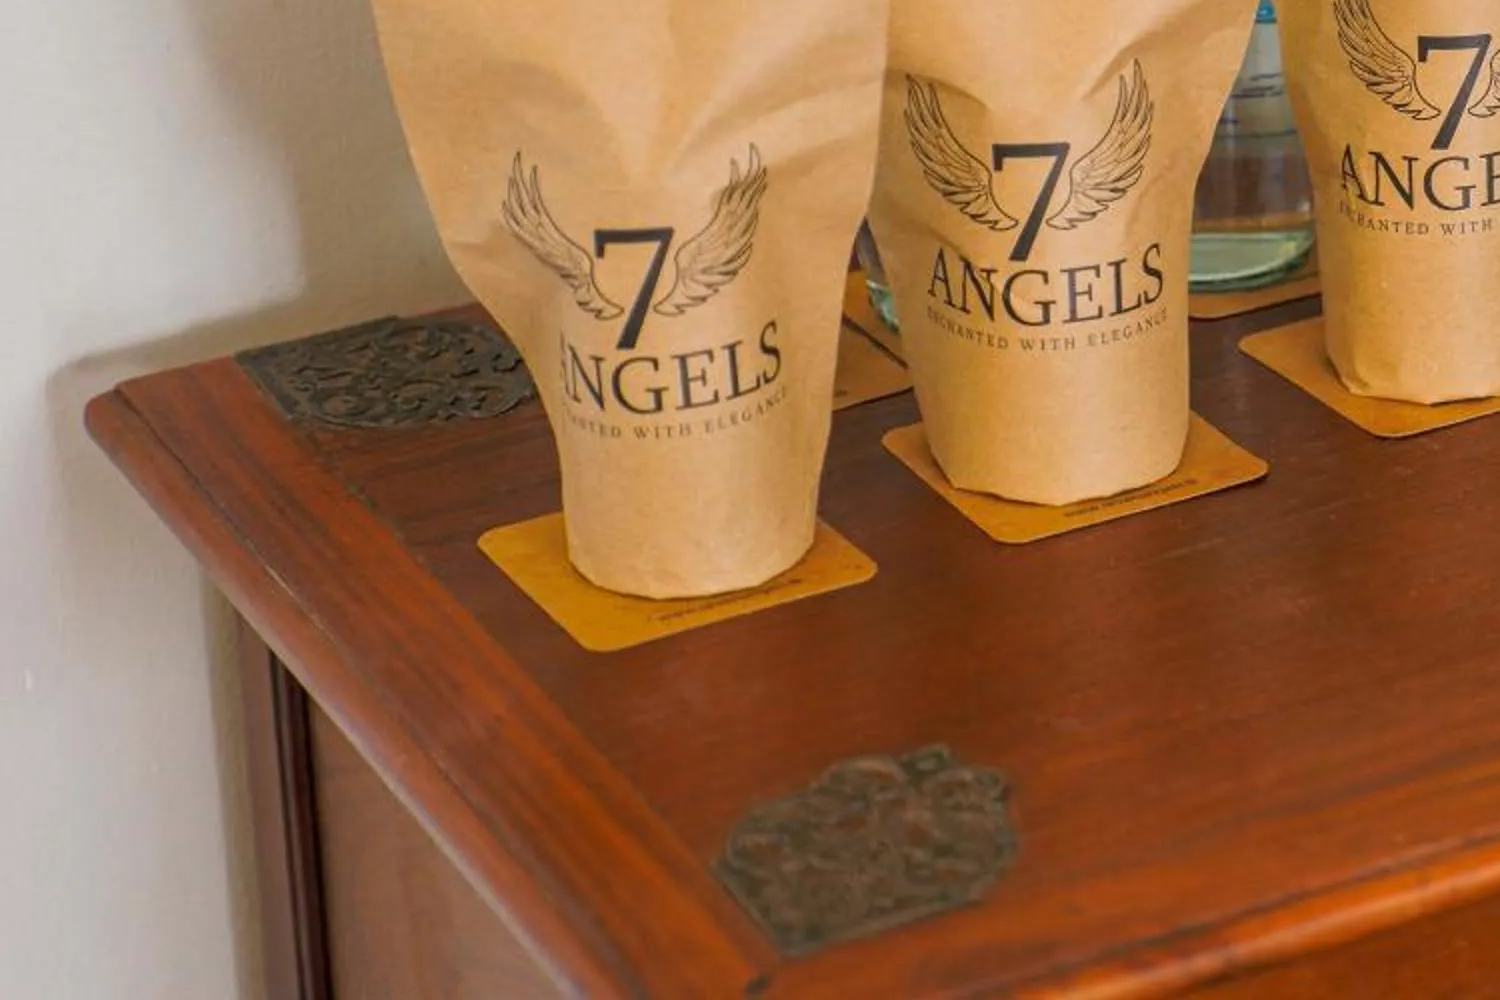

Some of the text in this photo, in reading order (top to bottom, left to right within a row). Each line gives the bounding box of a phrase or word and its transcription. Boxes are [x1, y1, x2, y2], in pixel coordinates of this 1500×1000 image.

[1417, 33, 1492, 150] 7
[992, 141, 1071, 262] 7
[1339, 198, 1430, 236] HANTED
[1440, 218, 1493, 237] WITH
[594, 226, 675, 350] 7
[927, 242, 1164, 327] ANGELS
[1019, 336, 1076, 352] WITH
[1087, 306, 1168, 348] ELEGANCE
[633, 424, 692, 440] WITH
